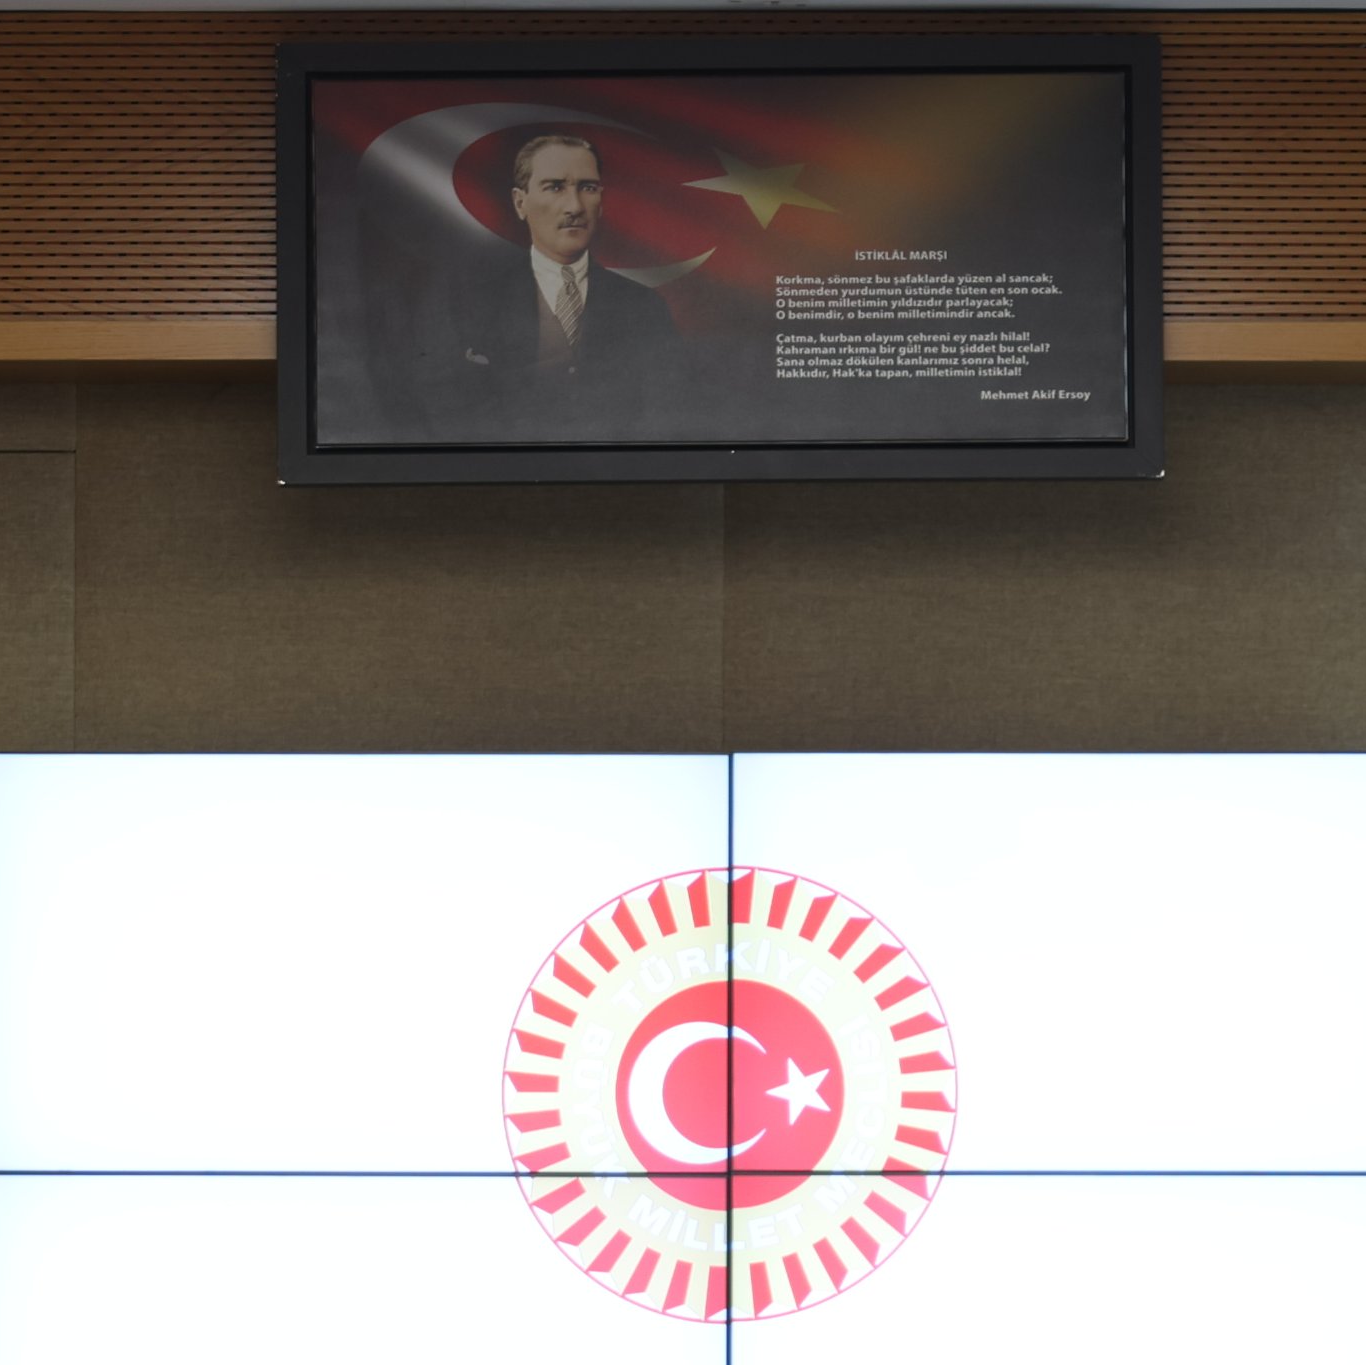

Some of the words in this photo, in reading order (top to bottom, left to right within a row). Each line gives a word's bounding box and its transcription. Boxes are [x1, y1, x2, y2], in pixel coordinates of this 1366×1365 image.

[909, 250, 948, 262] MARŞI
[775, 275, 826, 286] Korkma,
[826, 275, 874, 284] sönmez
[874, 274, 892, 284] bu
[892, 274, 956, 286] şafaklarda
[956, 274, 994, 285] yüzen
[994, 274, 1007, 283] al
[1007, 273, 1054, 284] sancak;
[774, 287, 839, 296] Sönmeden
[840, 286, 903, 298] yurdumun
[904, 286, 954, 295] üstünde
[955, 286, 988, 295] tüten
[1006, 287, 1029, 295] son
[1029, 285, 1064, 295] ocak.
[775, 298, 786, 308] O
[787, 298, 826, 308] benim
[827, 298, 889, 307] milletimin
[890, 298, 944, 309] yıldızıdır
[945, 297, 1014, 309] parlayacak;
[775, 310, 787, 320] O
[787, 310, 845, 321] benimdir,
[856, 310, 895, 319] benim
[896, 309, 975, 319] milletimindir
[975, 309, 1016, 318] ancak.
[775, 334, 818, 345] Çatma,
[819, 333, 862, 343] kurban
[863, 333, 905, 345] olayım
[906, 333, 951, 344] çehreni
[952, 335, 968, 344] ey
[969, 332, 998, 342] nazlı
[999, 332, 1031, 342] hilal!
[775, 345, 837, 354] Kahraman
[838, 345, 877, 354] ırkıma
[878, 345, 897, 354] bir
[898, 344, 922, 356] gül!
[923, 346, 939, 354] ne
[940, 344, 957, 353] bu
[959, 344, 997, 356] şiddet
[998, 344, 1015, 353] bu
[1016, 344, 1051, 353] celal?
[775, 357, 805, 366] Sana
[807, 357, 844, 366] olmaz
[845, 356, 895, 366] dökülen
[896, 356, 960, 365] kanlarımız
[996, 355, 1030, 366] helal,
[775, 369, 830, 379] Hakkıdır,
[831, 368, 873, 378] Hak'ka
[874, 368, 913, 380] tapan,
[914, 368, 976, 377] milletimin
[977, 367, 1023, 377] istiklal!
[979, 390, 1029, 400] Mehmet
[1031, 390, 1056, 400] Akif
[1058, 390, 1092, 401] Ersoy
